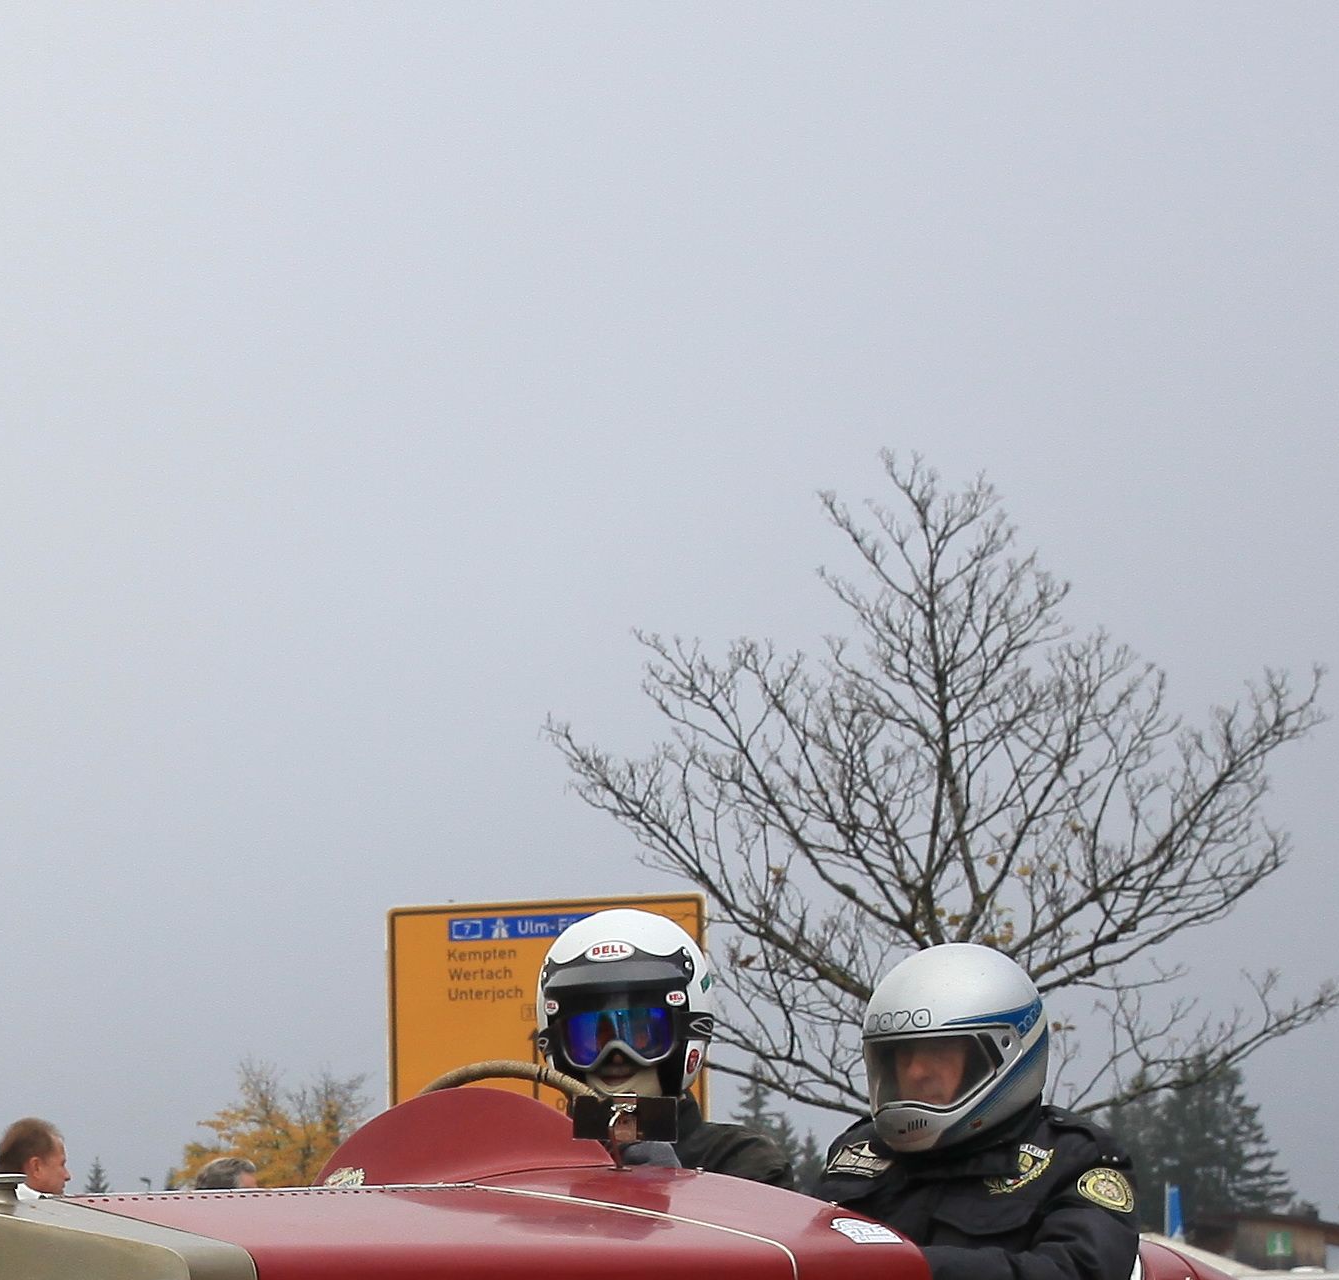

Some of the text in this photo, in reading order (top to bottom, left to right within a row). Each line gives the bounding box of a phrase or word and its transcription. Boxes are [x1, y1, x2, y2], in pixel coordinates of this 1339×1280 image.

[447, 948, 518, 963] Kempten
[592, 945, 628, 956] BELL
[449, 967, 513, 981] Wertach
[447, 986, 523, 1002] Unterjoch
